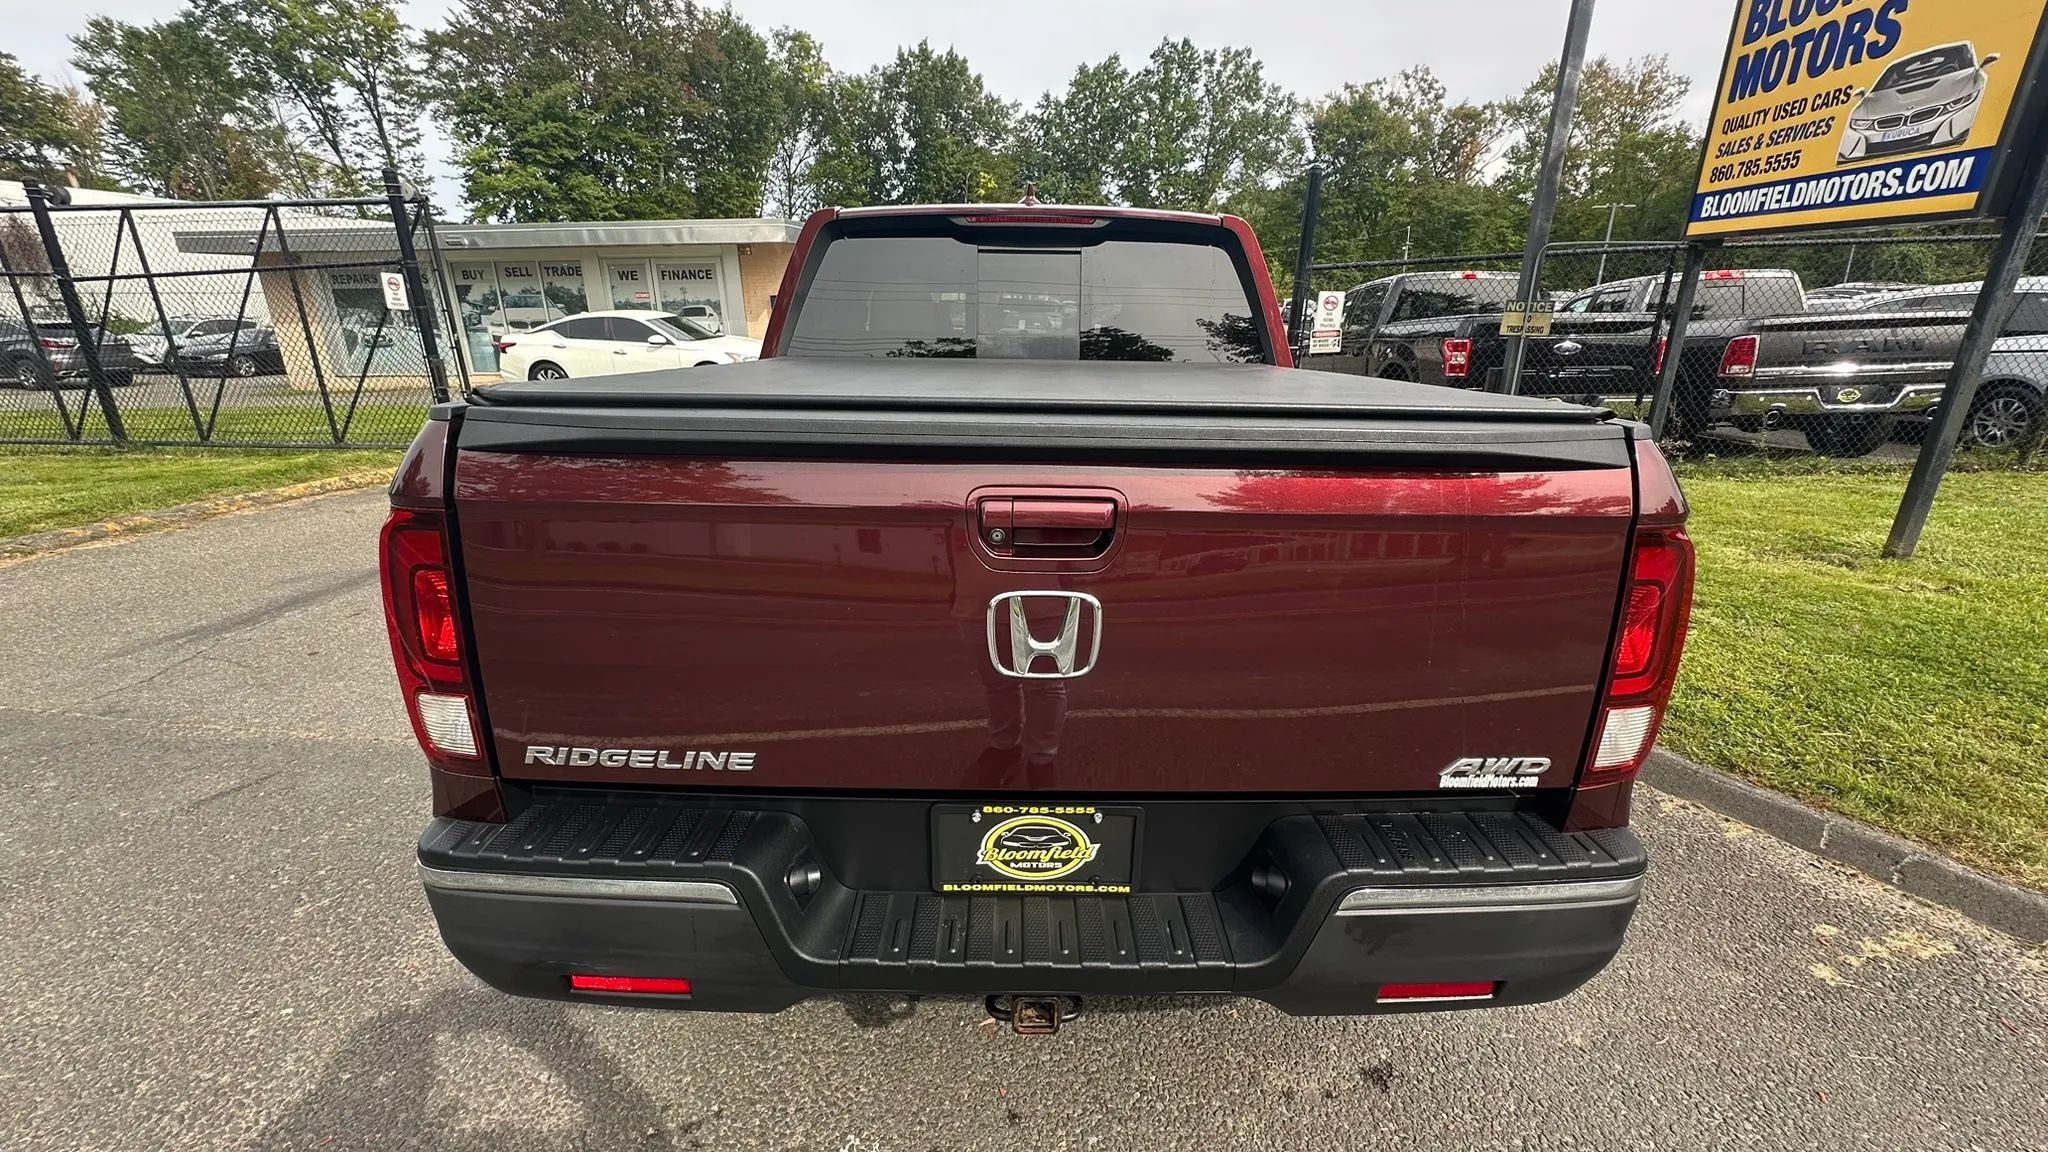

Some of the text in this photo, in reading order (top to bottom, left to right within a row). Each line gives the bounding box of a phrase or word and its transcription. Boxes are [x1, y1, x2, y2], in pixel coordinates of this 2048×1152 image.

[1727, 0, 1909, 104] MOTORS
[1722, 84, 1853, 135] QUALITY USED CARS
[1715, 116, 1836, 159] SALES & SERVICES
[1709, 149, 1802, 184] 860.785.5555
[1700, 156, 1975, 218] BLOOMFIELDMOTORS.COM
[462, 266, 583, 280] BUY SELL TRADE
[617, 269, 713, 281] WE FINANCE
[524, 745, 757, 771] RIDGELINE
[1438, 757, 1552, 775] AWD
[1439, 774, 1539, 788] BloomfieldMotors.com
[982, 806, 1096, 814] 860-785-5555
[983, 844, 1094, 862] Bloomfield
[943, 884, 1130, 893] BLOOMFIELDMOTORS.COM
